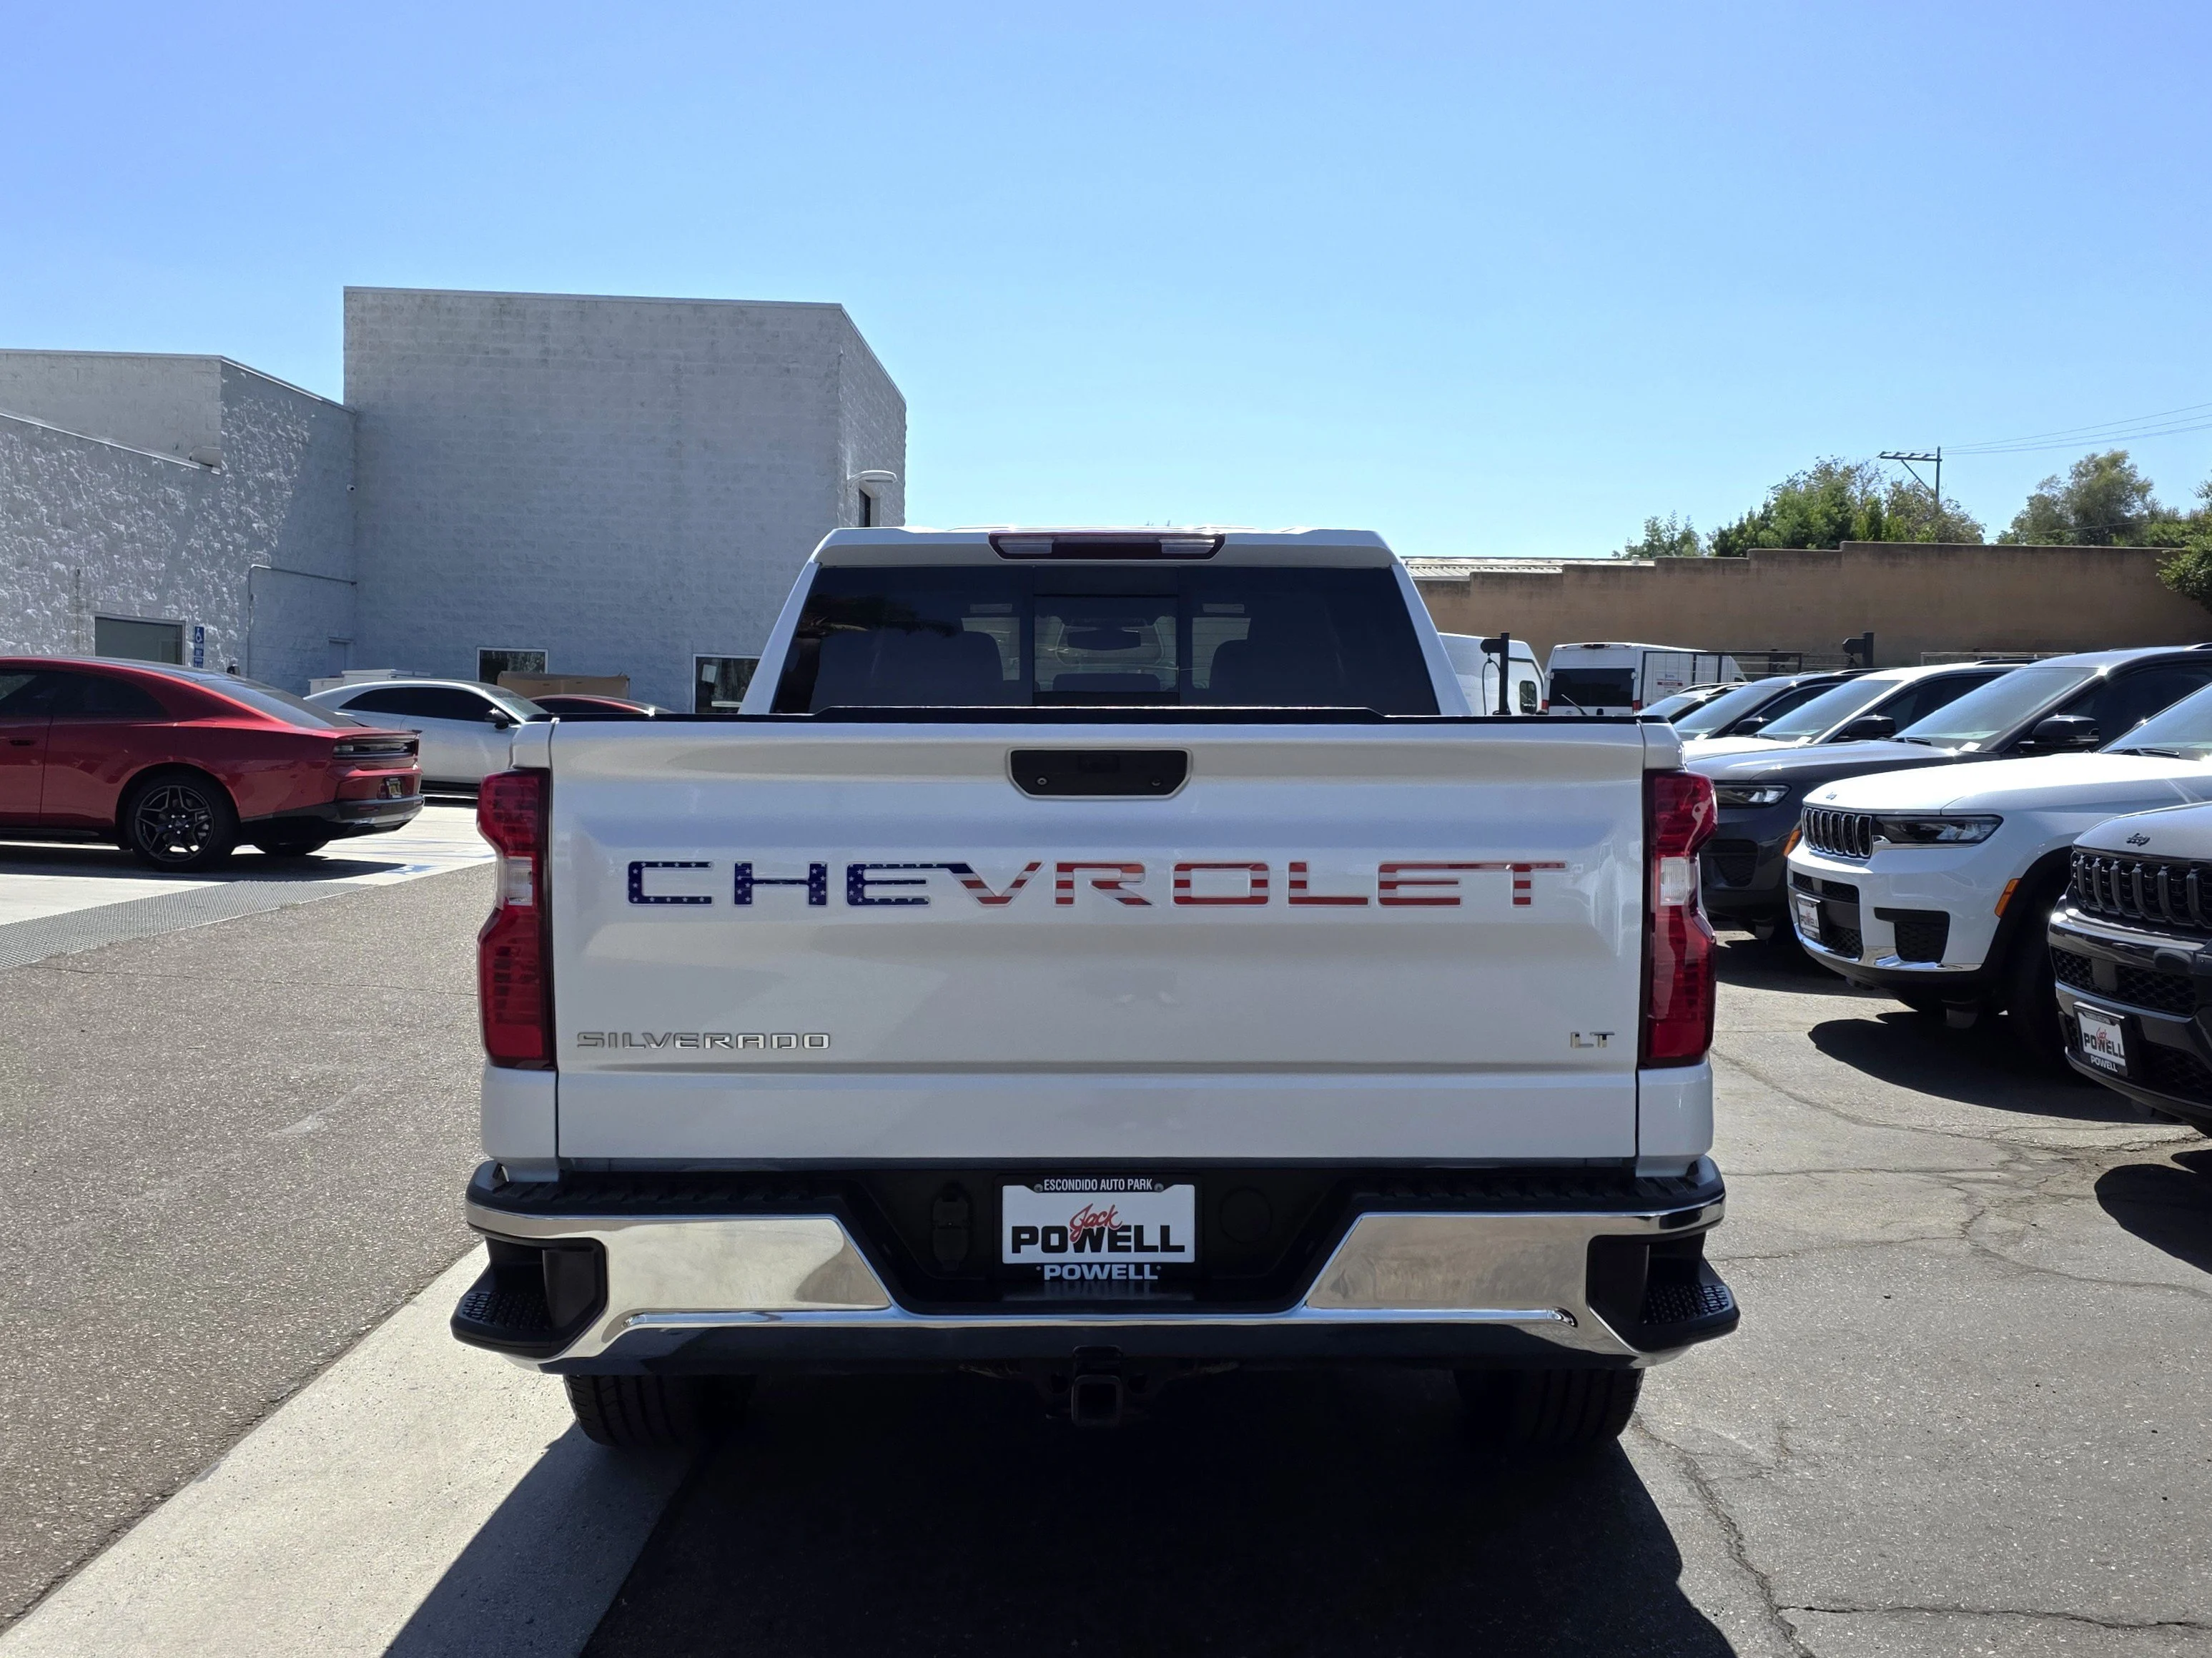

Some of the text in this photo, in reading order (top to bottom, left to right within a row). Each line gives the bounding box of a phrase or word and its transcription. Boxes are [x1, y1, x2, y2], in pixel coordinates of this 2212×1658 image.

[628, 861, 1568, 907] CHEVROLET
[577, 1032, 831, 1050] SILVERADO
[1570, 1031, 1615, 1048] LT
[2083, 1032, 2125, 1059] POWELL
[2090, 1055, 2118, 1073] POWELL
[1044, 1179, 1152, 1191] ESCONDIDO AUTO PARK
[1069, 1203, 1123, 1243] Jack
[1012, 1225, 1185, 1253] POWELL
[1043, 1264, 1159, 1280] POWELL
